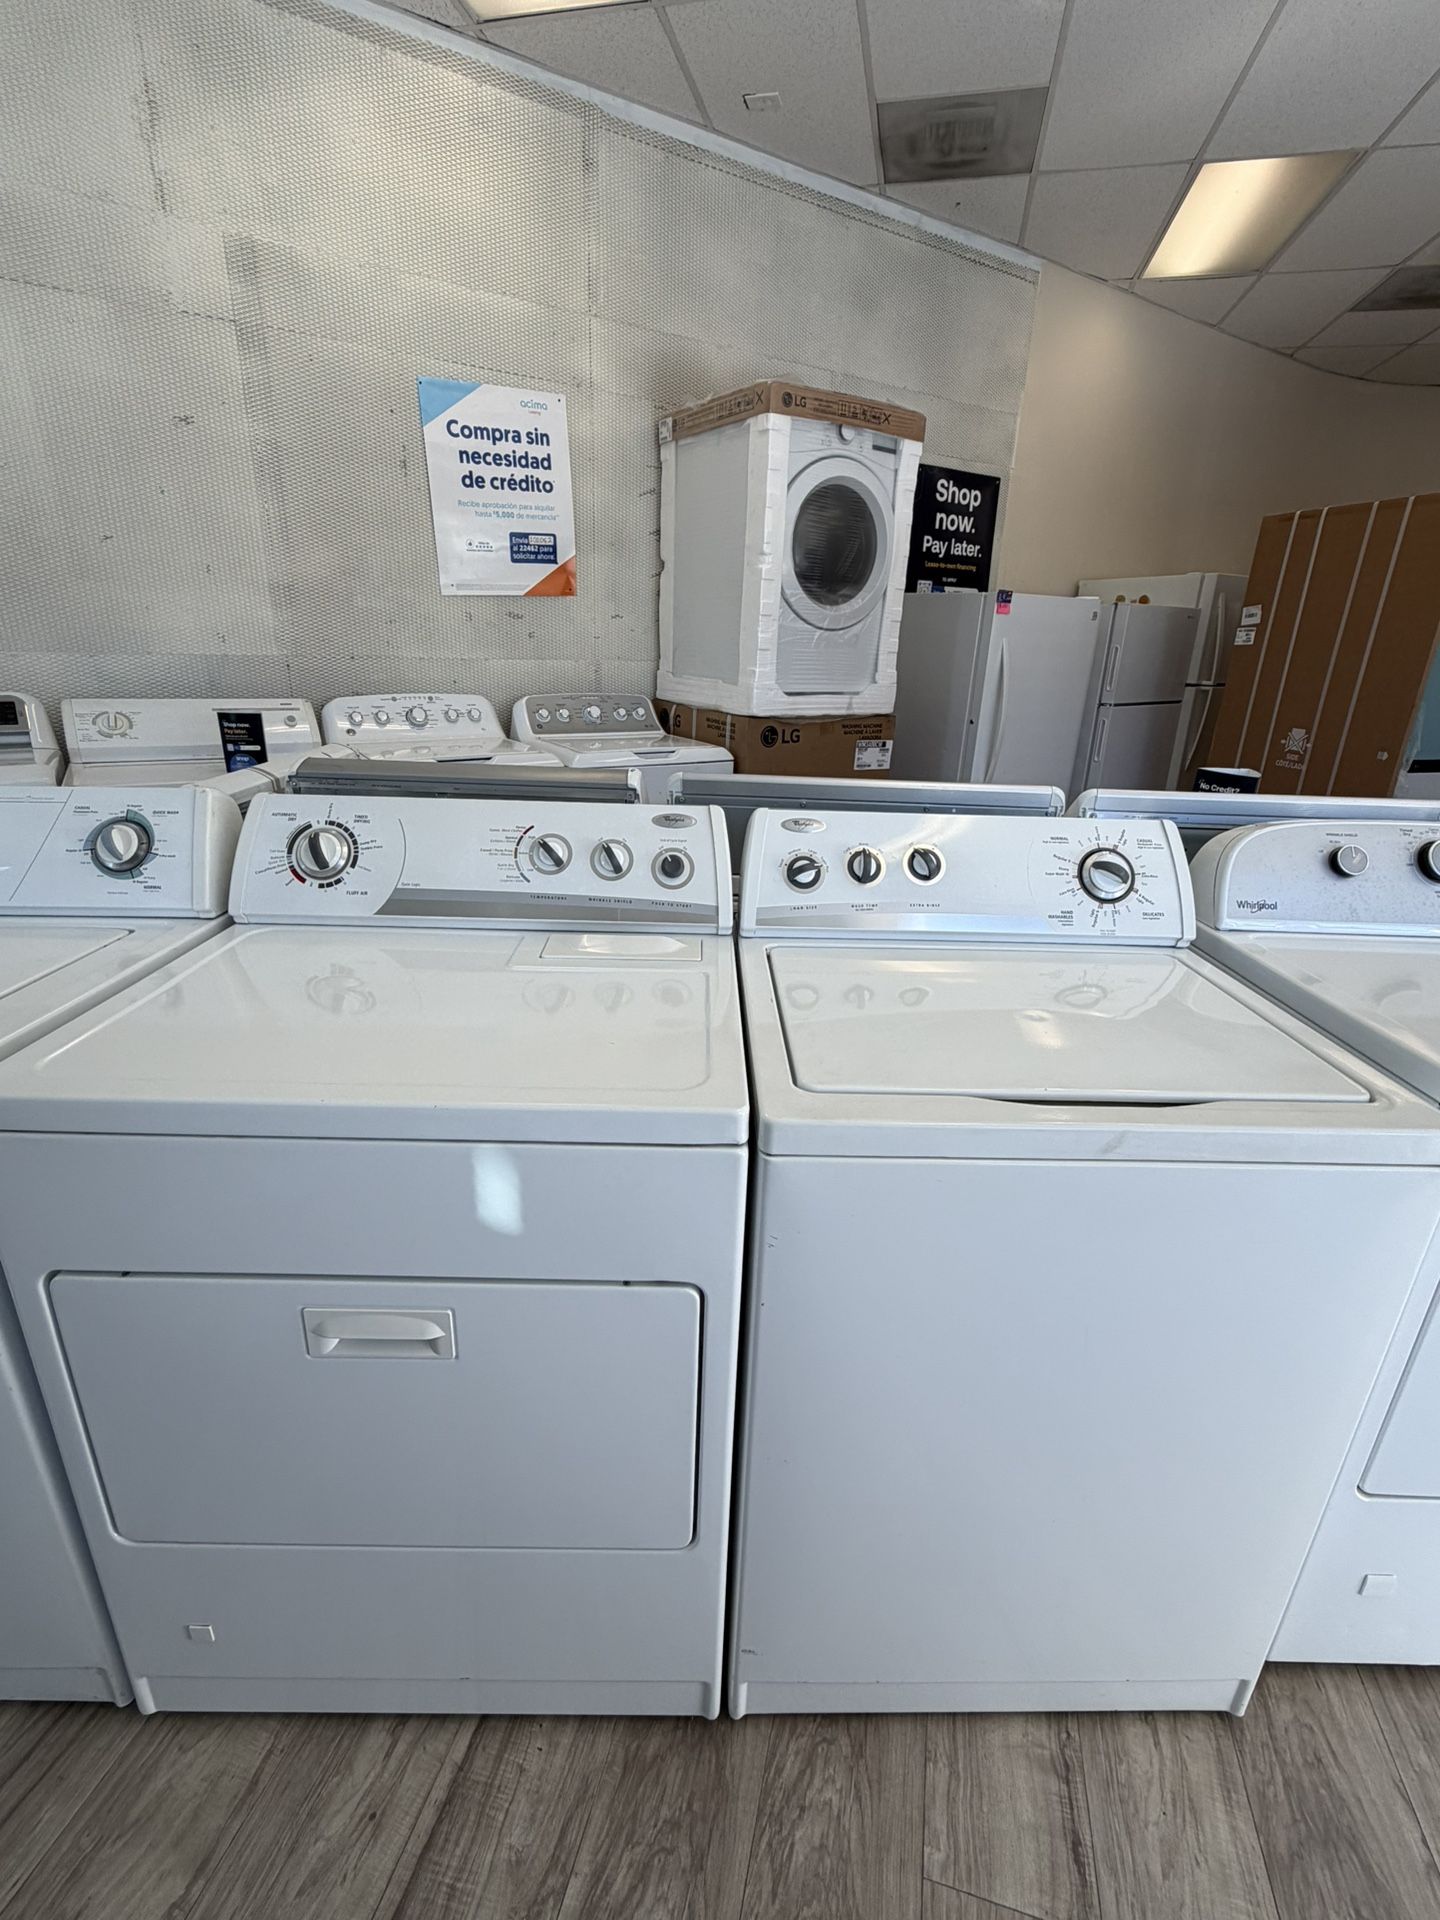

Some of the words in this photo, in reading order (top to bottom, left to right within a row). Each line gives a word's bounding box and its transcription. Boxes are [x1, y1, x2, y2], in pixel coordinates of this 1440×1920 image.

[520, 399, 548, 410] acima
[794, 395, 807, 408] LG
[446, 419, 522, 445] Compra
[525, 427, 550, 446] sin
[458, 450, 552, 470] necesidad
[461, 470, 485, 489] de
[490, 474, 553, 493] crédito
[936, 478, 982, 512] Shop
[457, 499, 480, 508] Recibe
[481, 500, 518, 510] aprobación
[475, 510, 492, 518] hasta
[935, 512, 975, 534] now.
[922, 535, 948, 558] Pay
[950, 538, 982, 558] later.
[513, 553, 536, 561] solicitar
[781, 728, 801, 745] LG
[1199, 782, 1210, 790] No
[1211, 784, 1240, 793] Credit?
[1236, 899, 1278, 914] Whirlpool
